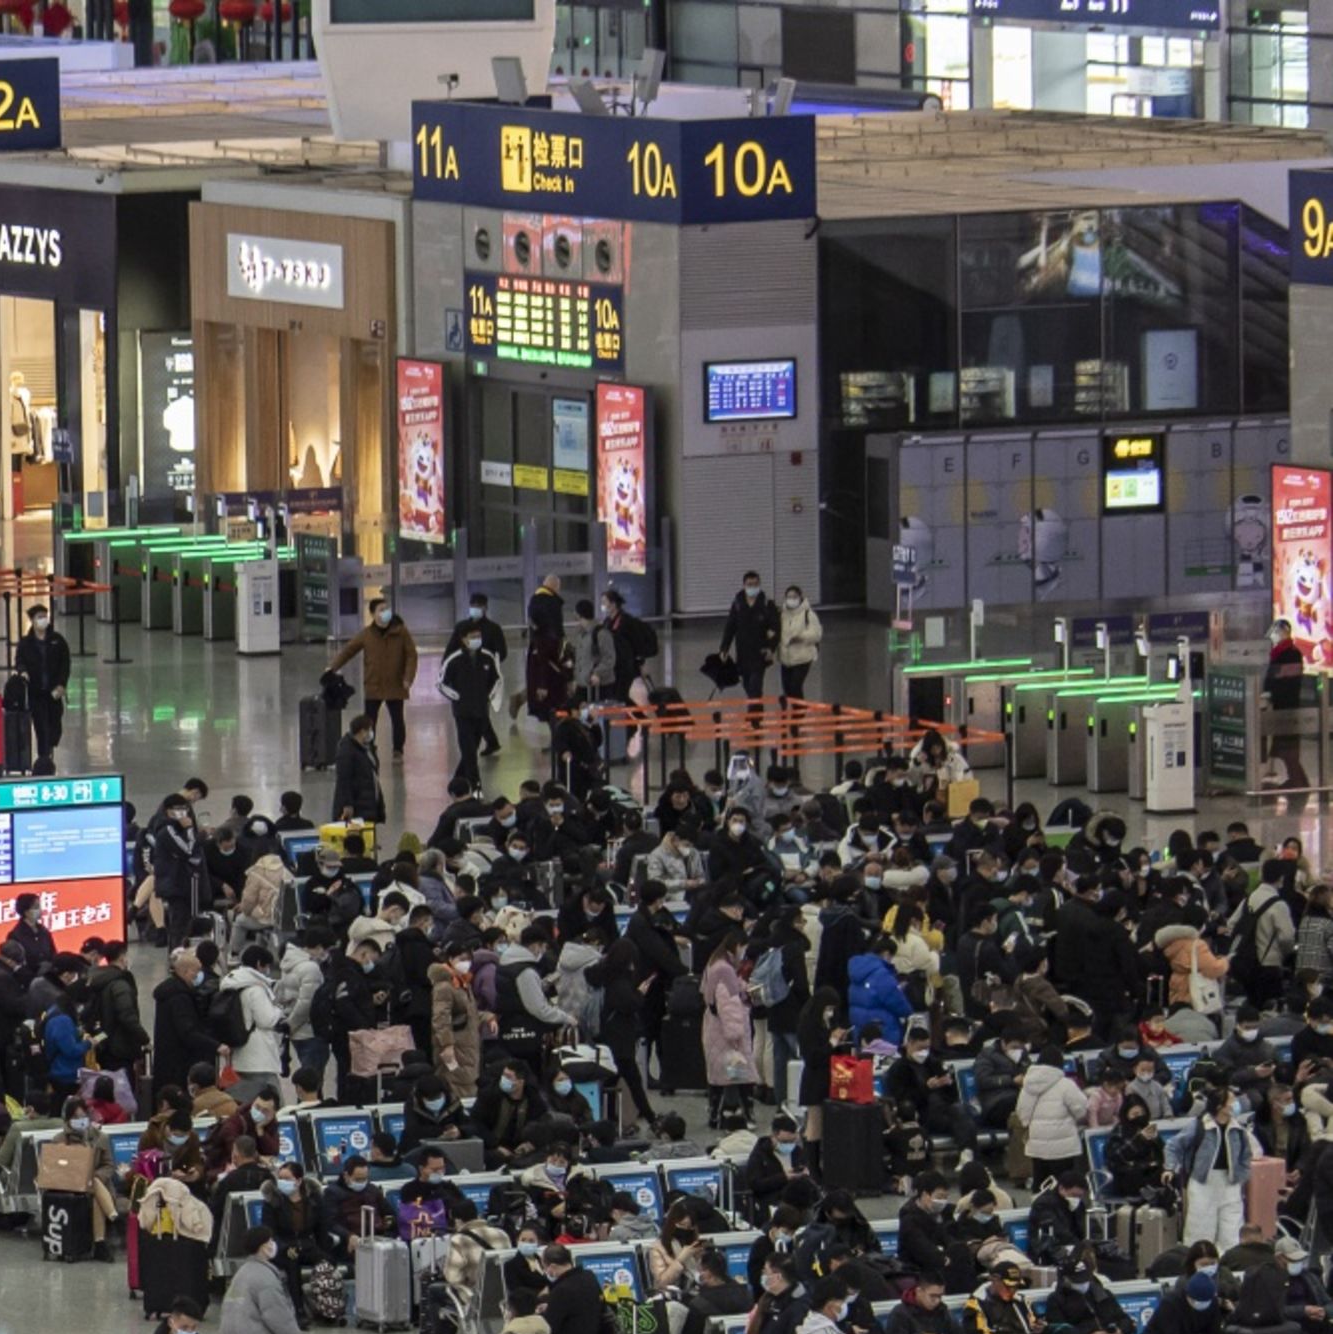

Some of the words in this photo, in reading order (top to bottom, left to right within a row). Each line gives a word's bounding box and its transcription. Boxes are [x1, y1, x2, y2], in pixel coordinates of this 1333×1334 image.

[416, 125, 459, 181] 11A
[533, 134, 583, 171] 检票口
[704, 141, 792, 196] 10A
[533, 174, 563, 192] Check
[564, 177, 574, 193] in
[627, 142, 677, 198] 10A
[469, 284, 493, 316] 11A
[595, 298, 620, 330] 10A
[944, 457, 954, 473] E
[41, 785, 68, 802] 8-30
